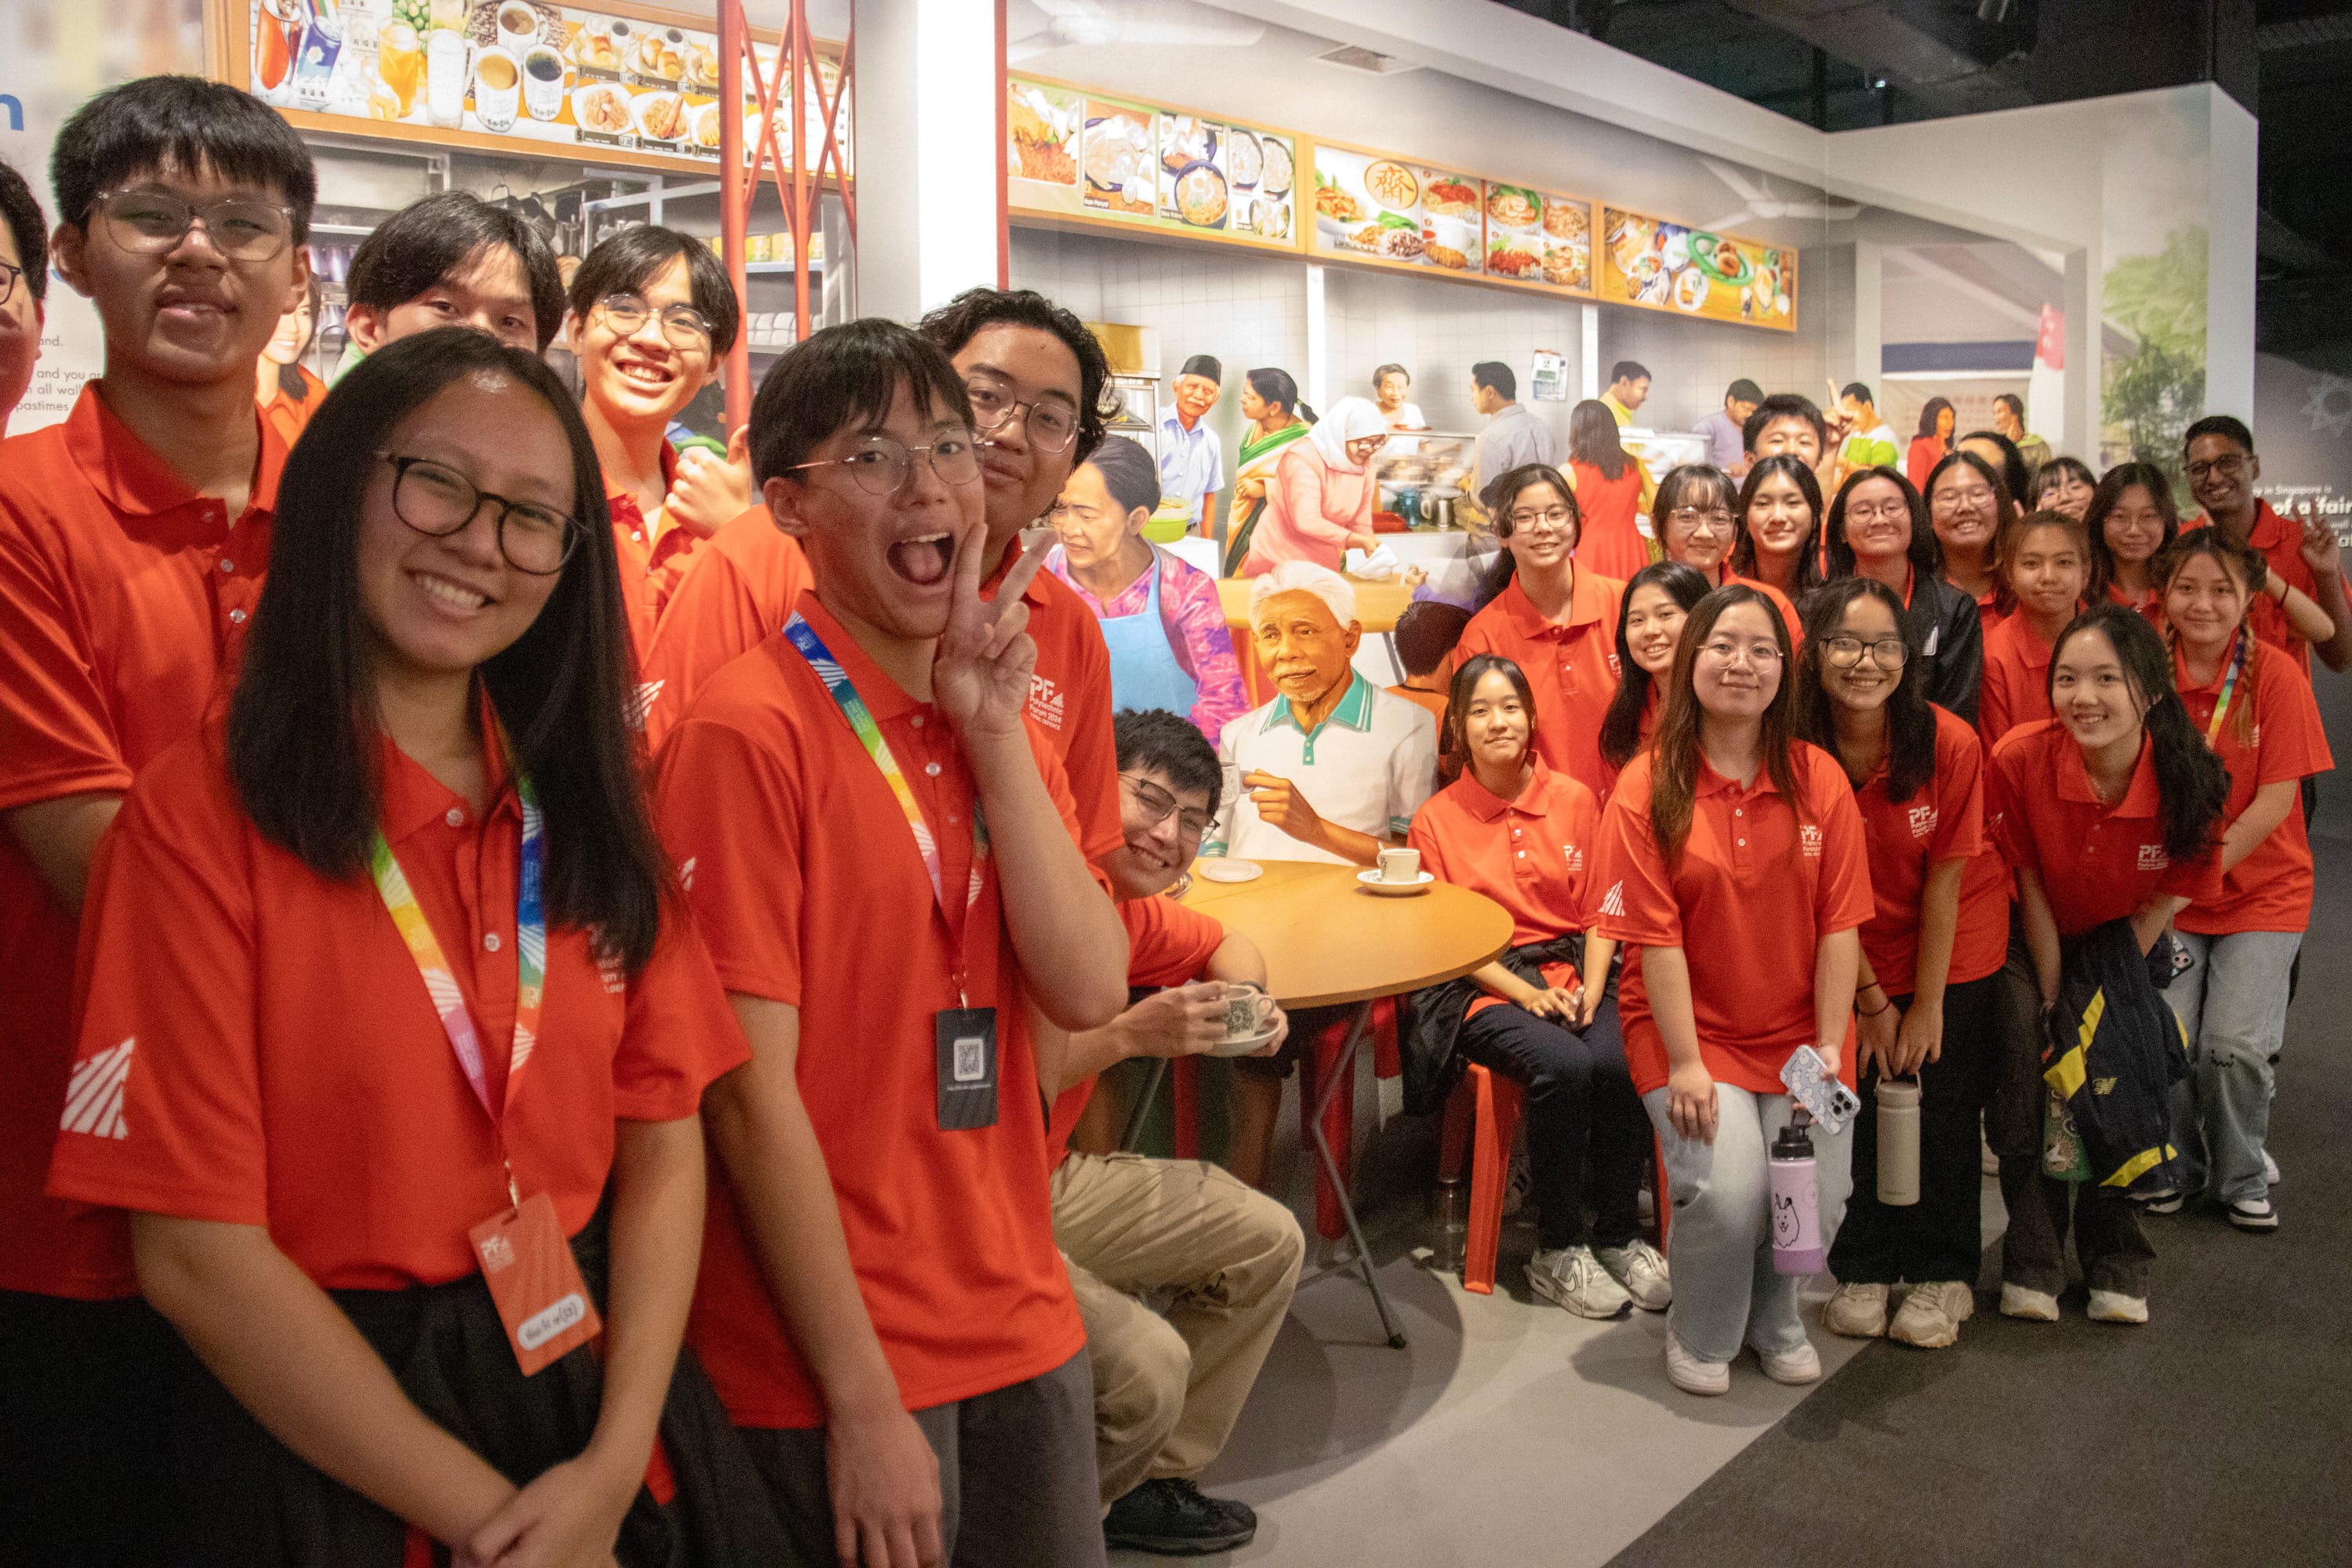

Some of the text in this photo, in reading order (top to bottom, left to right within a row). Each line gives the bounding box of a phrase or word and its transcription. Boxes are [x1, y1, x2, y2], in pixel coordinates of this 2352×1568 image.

[37, 367, 60, 379] and
[64, 372, 85, 382] you
[37, 383, 52, 394] all
[16, 401, 69, 412] pastimes
[2275, 483, 2322, 497] Singapore
[2272, 496, 2294, 516] of
[2297, 501, 2311, 515] a
[1029, 674, 1054, 701] PF
